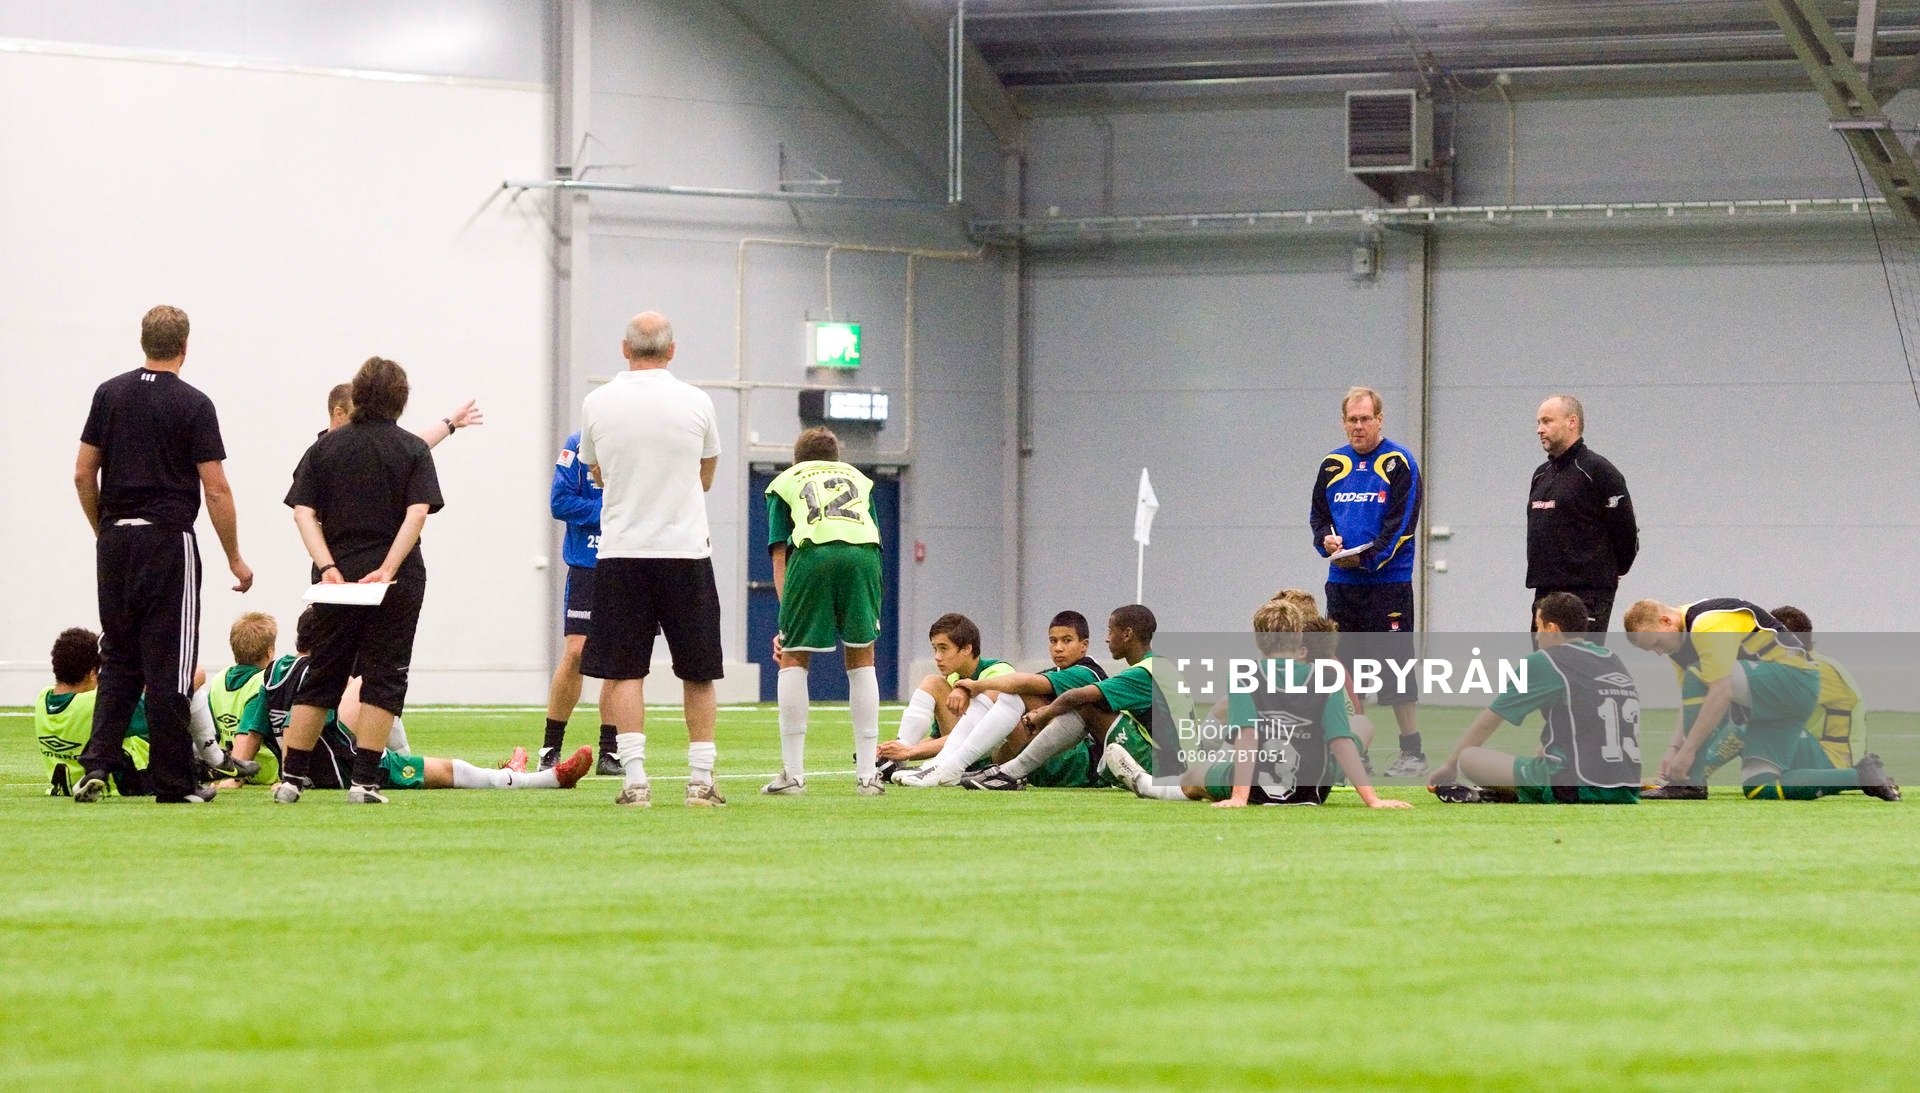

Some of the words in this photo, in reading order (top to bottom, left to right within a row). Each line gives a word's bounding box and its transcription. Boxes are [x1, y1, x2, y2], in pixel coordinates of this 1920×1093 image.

[799, 477, 864, 525] 12
[1333, 492, 1379, 503] ODDSET
[1257, 737, 1301, 800] 3
